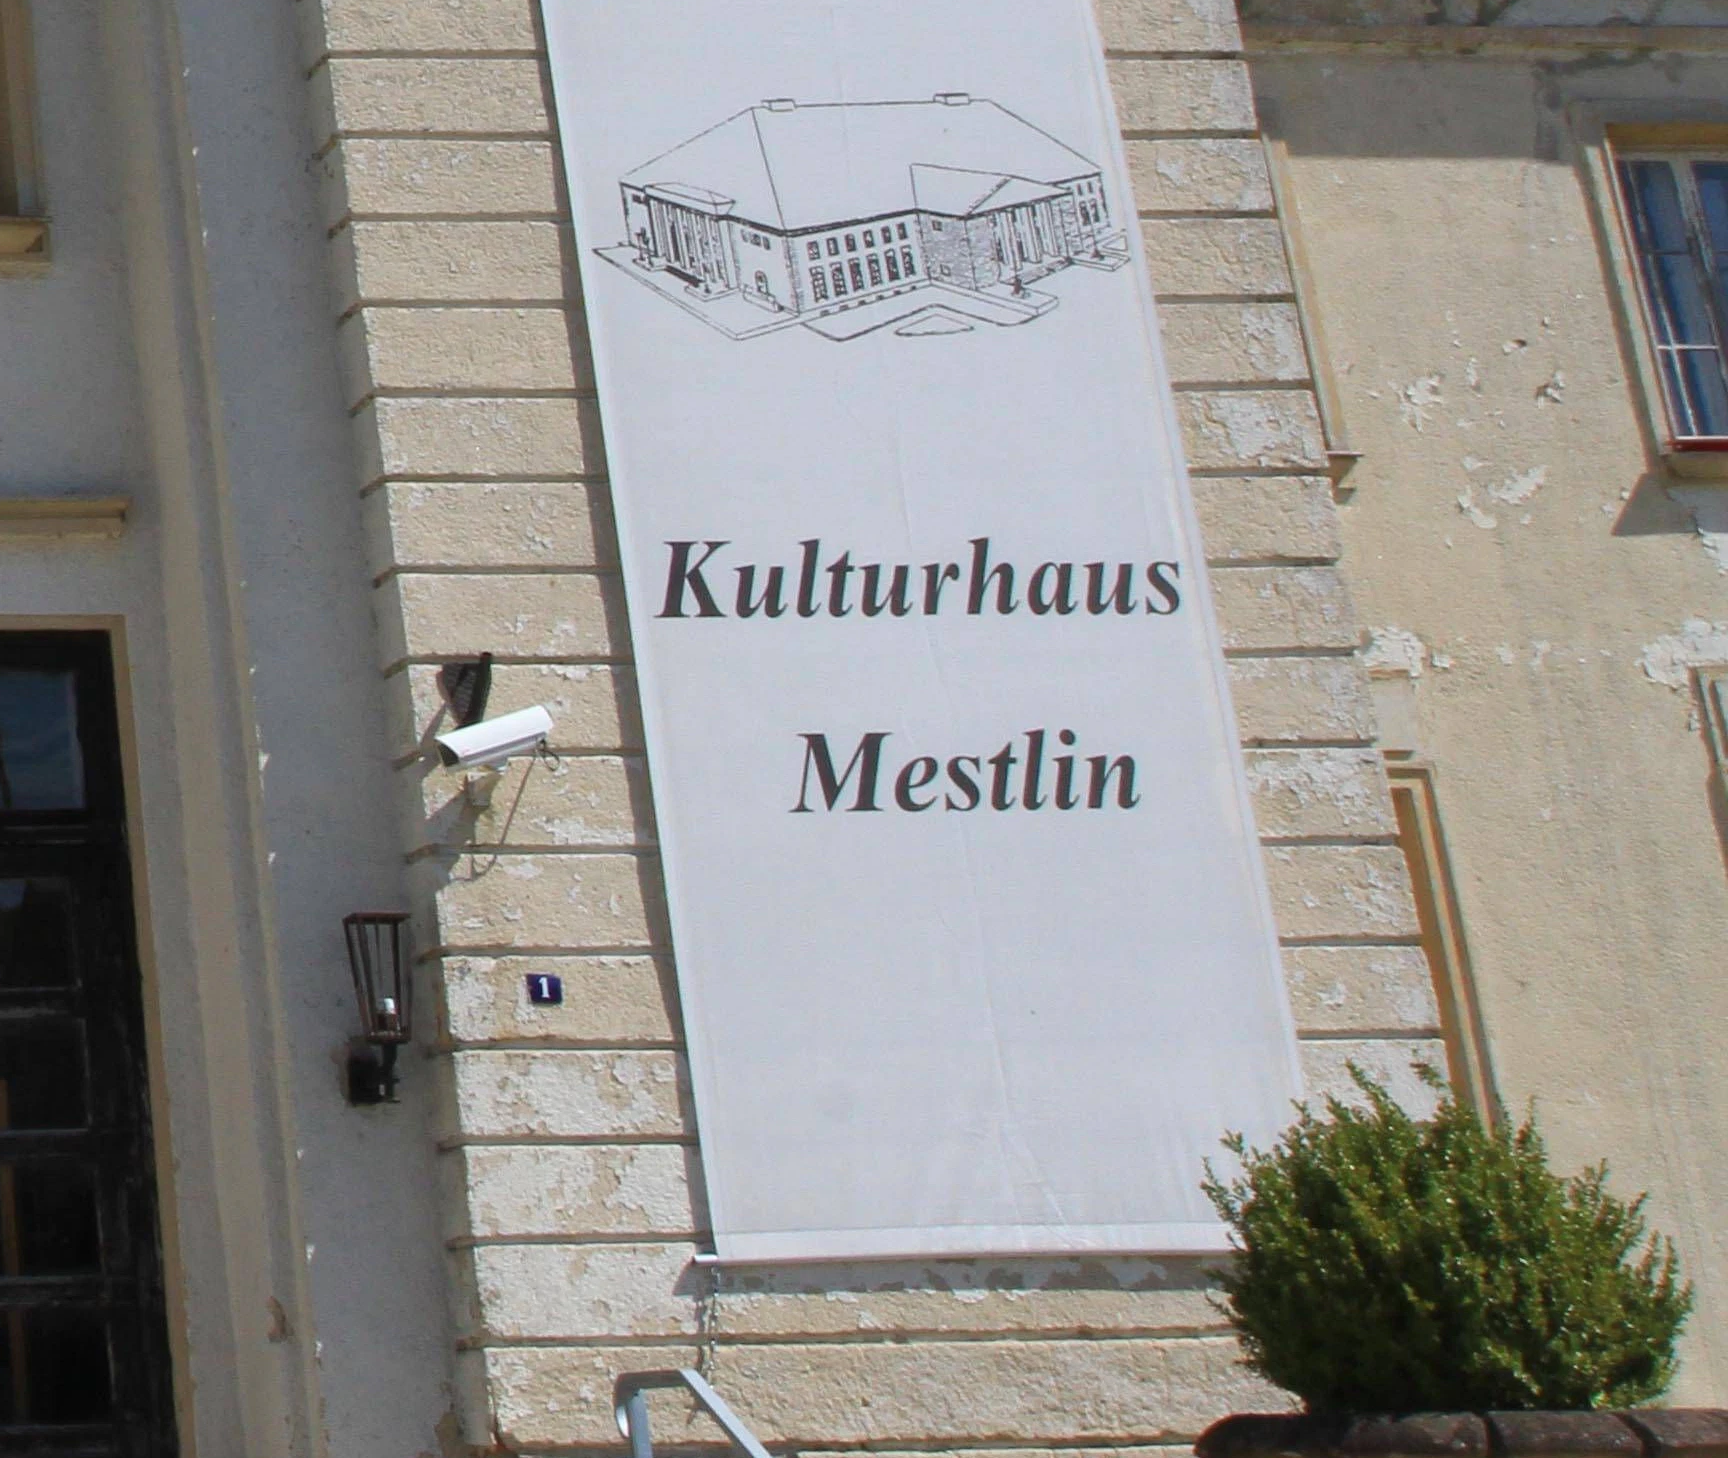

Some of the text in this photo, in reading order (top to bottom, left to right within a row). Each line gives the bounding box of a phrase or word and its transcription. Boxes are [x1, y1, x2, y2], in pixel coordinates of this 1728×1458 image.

[655, 536, 1183, 620] Kulturhaus
[790, 728, 1140, 814] Mestlin
[538, 976, 551, 999] 1
